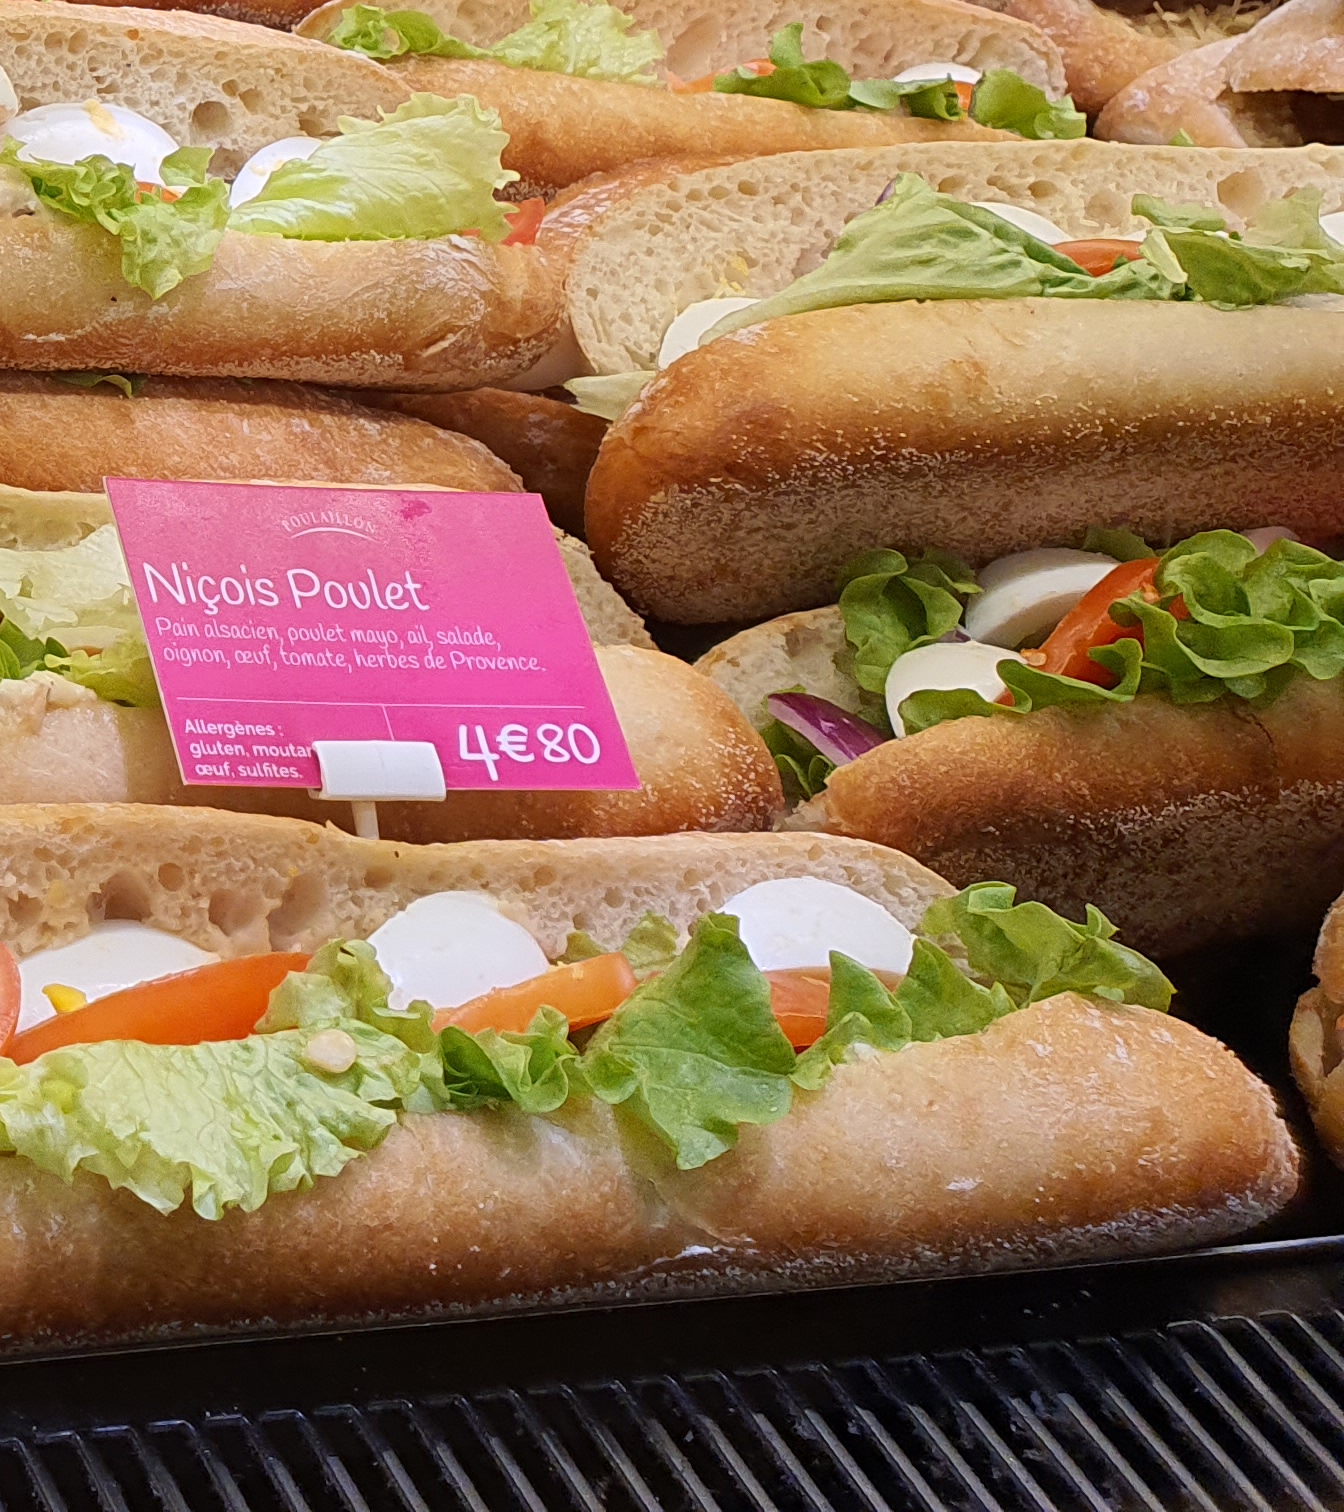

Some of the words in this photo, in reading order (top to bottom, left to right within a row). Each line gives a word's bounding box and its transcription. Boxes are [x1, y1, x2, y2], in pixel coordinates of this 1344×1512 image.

[281, 510, 376, 534] POULAILLON
[142, 561, 279, 615] Niçois
[287, 568, 430, 611] Poulet
[155, 617, 200, 637] Pain
[204, 619, 284, 645] alsacien,
[287, 623, 347, 646] poulet
[351, 629, 405, 650] mayo,
[407, 624, 434, 648] ail,
[436, 625, 502, 652] salade,
[163, 642, 231, 670] oignon,
[234, 644, 278, 671] œuf,
[279, 646, 353, 674] tomate,
[353, 648, 420, 669] herbes
[424, 650, 447, 669] de
[449, 650, 547, 672] Provence.
[185, 719, 275, 739] Allergènes
[189, 740, 250, 758] gluten,
[252, 743, 313, 758] moutar
[458, 722, 602, 783] 4€80
[195, 761, 236, 778] œuf,
[238, 762, 303, 779] sulfites.
